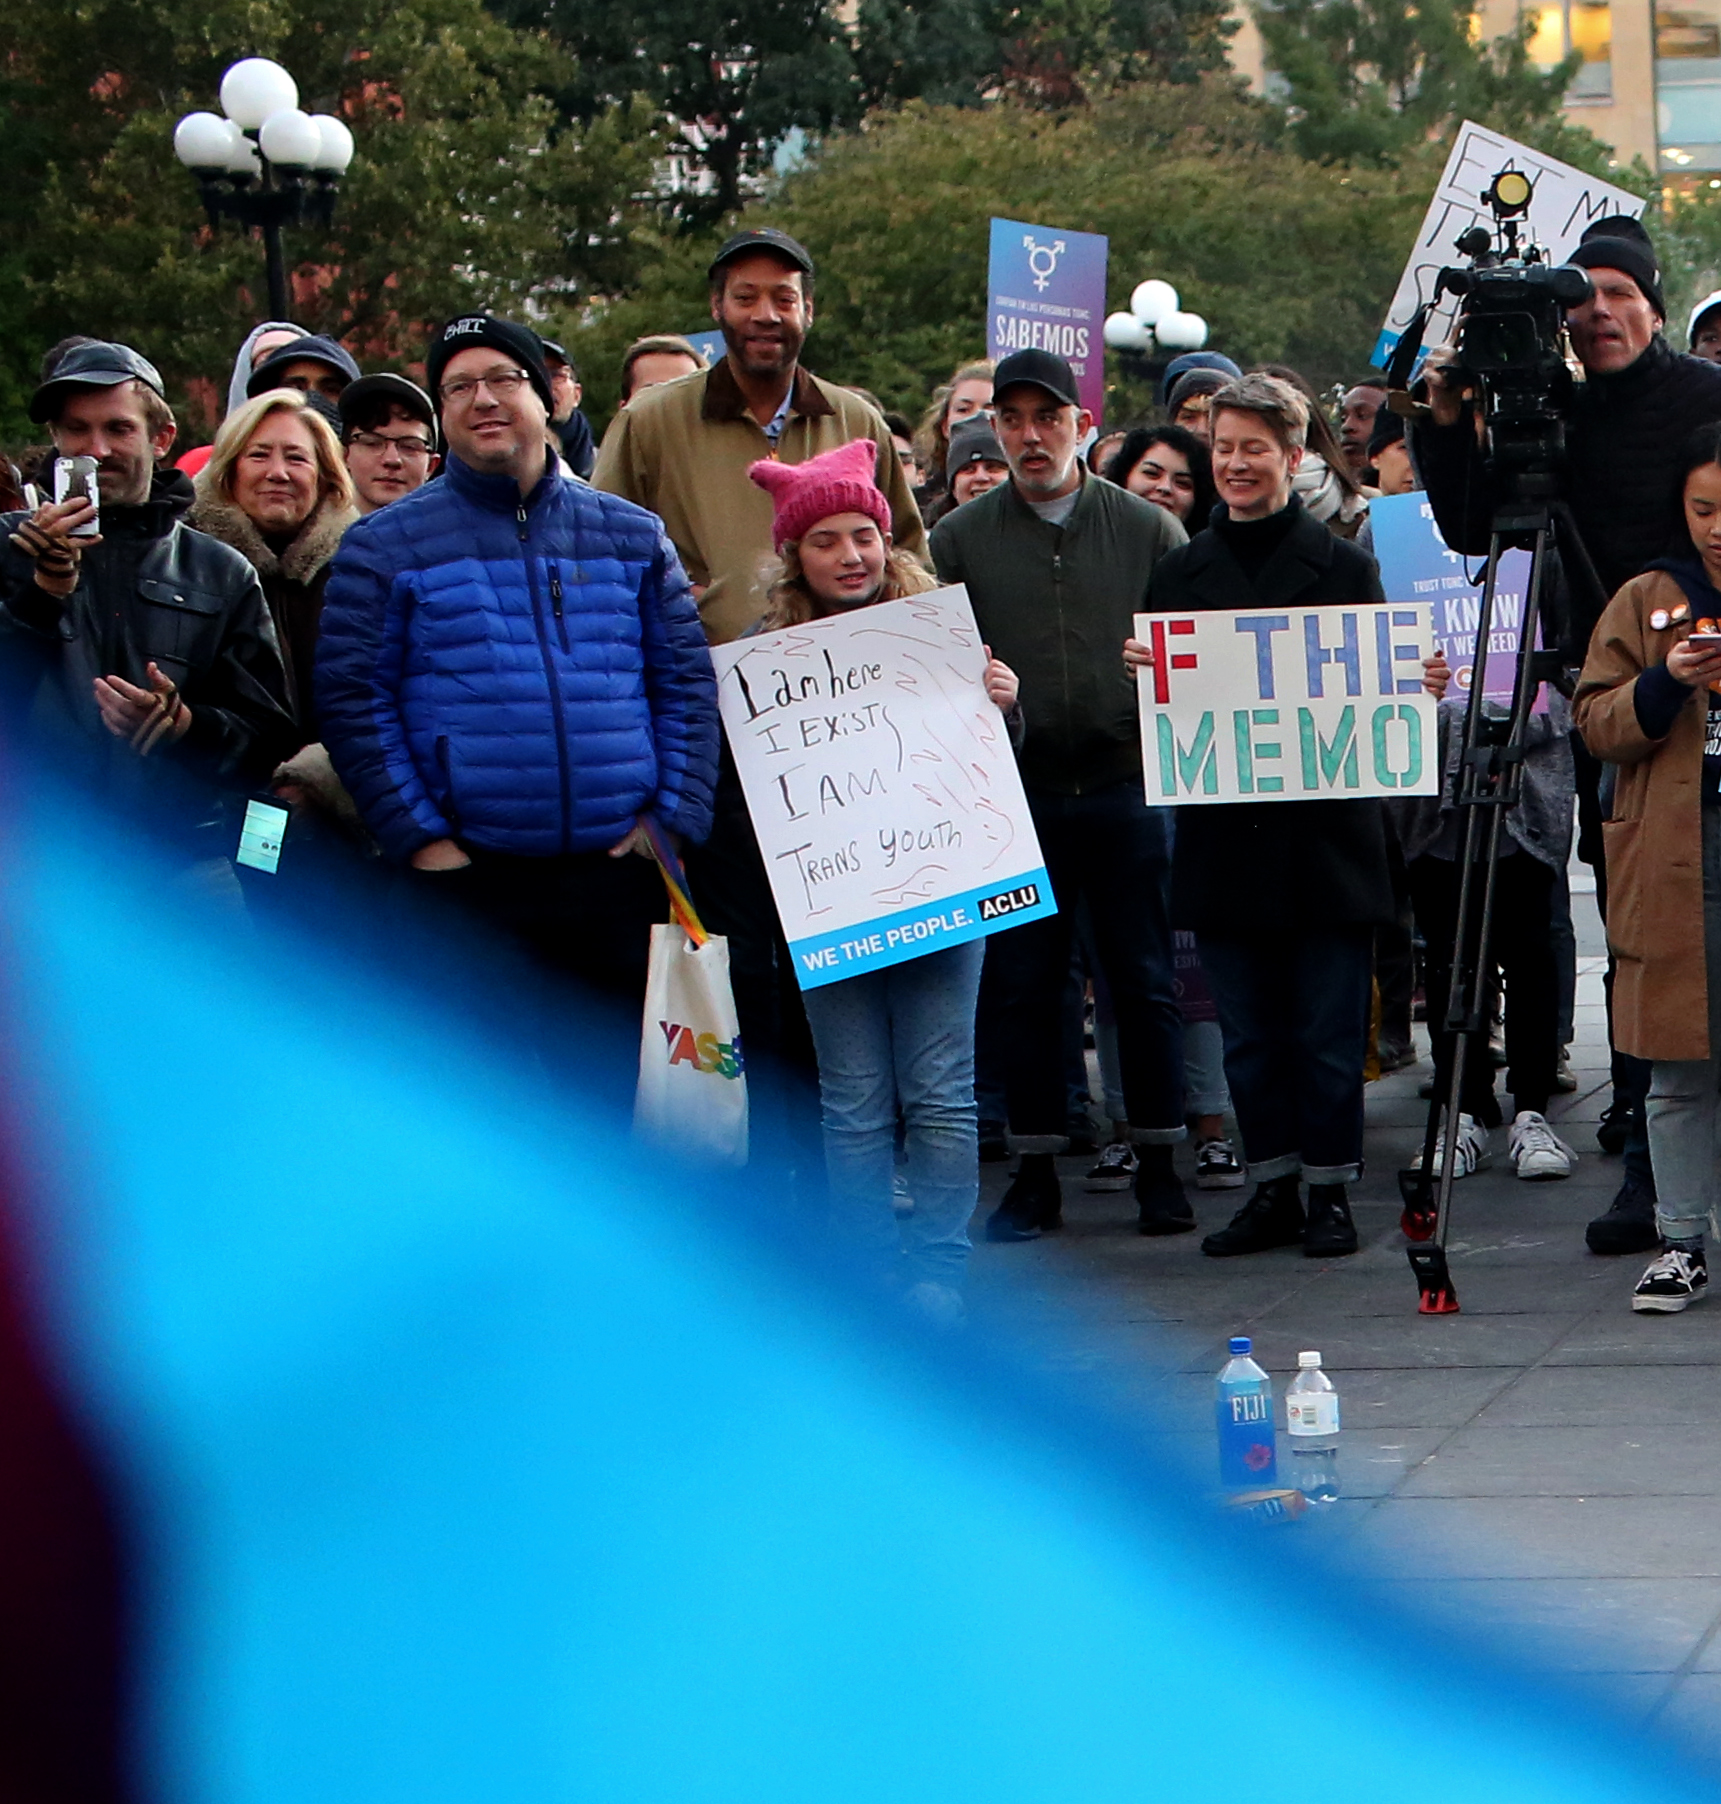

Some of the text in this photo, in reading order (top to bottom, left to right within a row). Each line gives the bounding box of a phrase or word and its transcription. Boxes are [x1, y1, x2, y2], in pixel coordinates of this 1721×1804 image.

[995, 313, 1090, 359] SABEMOS
[1413, 578, 1439, 593] TRUST
[1150, 611, 1423, 704] F THE
[1453, 635, 1477, 656] WE
[1486, 632, 1517, 654] EED
[823, 649, 883, 699] here
[757, 723, 790, 755] I
[1156, 704, 1423, 796] MEMO
[771, 763, 888, 822] I AM
[801, 885, 1037, 971] WE THE PEOPLE. ACLU
[1232, 1394, 1267, 1422] FIJI
